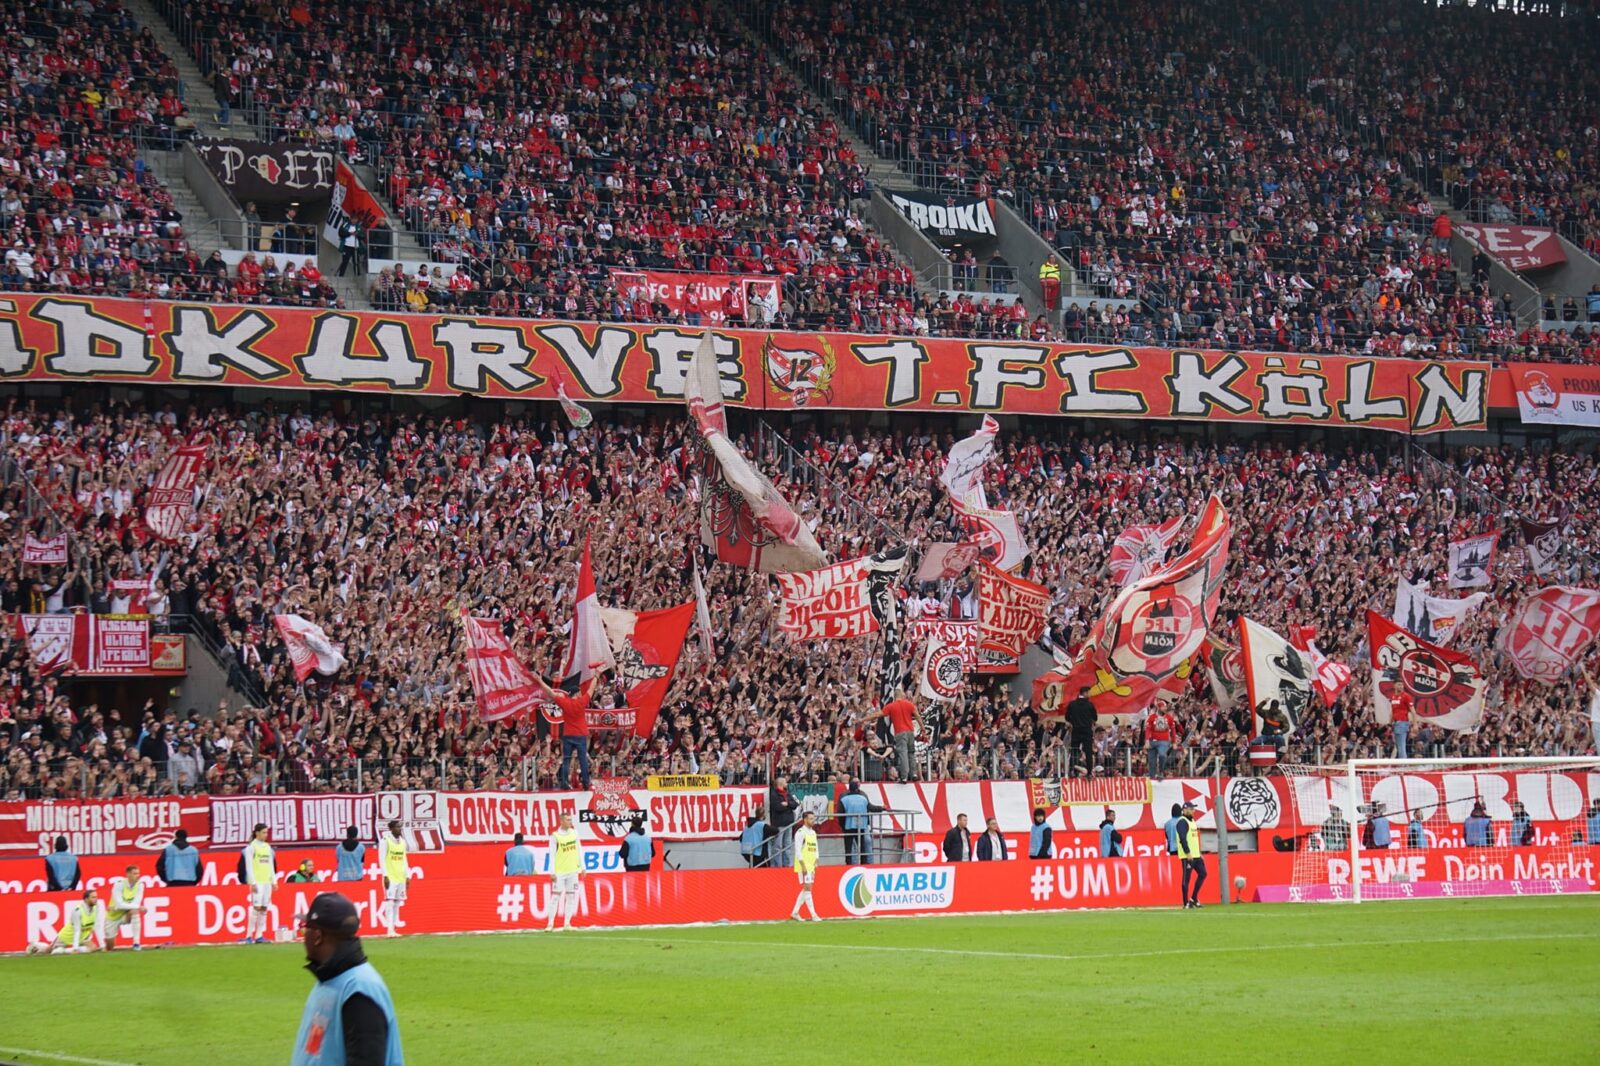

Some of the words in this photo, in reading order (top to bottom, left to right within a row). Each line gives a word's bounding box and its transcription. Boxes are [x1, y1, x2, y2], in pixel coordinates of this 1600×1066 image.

[892, 194, 997, 236] TROIKA
[1166, 352, 1487, 432] KÖLN
[1573, 400, 1587, 412] US
[380, 794, 400, 819] 0
[415, 794, 434, 818] 2
[1062, 777, 1148, 805] STADIONVERBOT
[1294, 773, 1600, 825] HORD
[26, 800, 181, 831] MÜNGERSDORFER
[447, 797, 577, 836] DOMSTADT
[650, 792, 765, 833] SYNDIKAT
[875, 871, 947, 892] NABU
[1327, 856, 1426, 886] REWE
[1443, 853, 1504, 882] Dein
[1513, 852, 1596, 887] Markt
[875, 892, 945, 906] KLIMAFONDS
